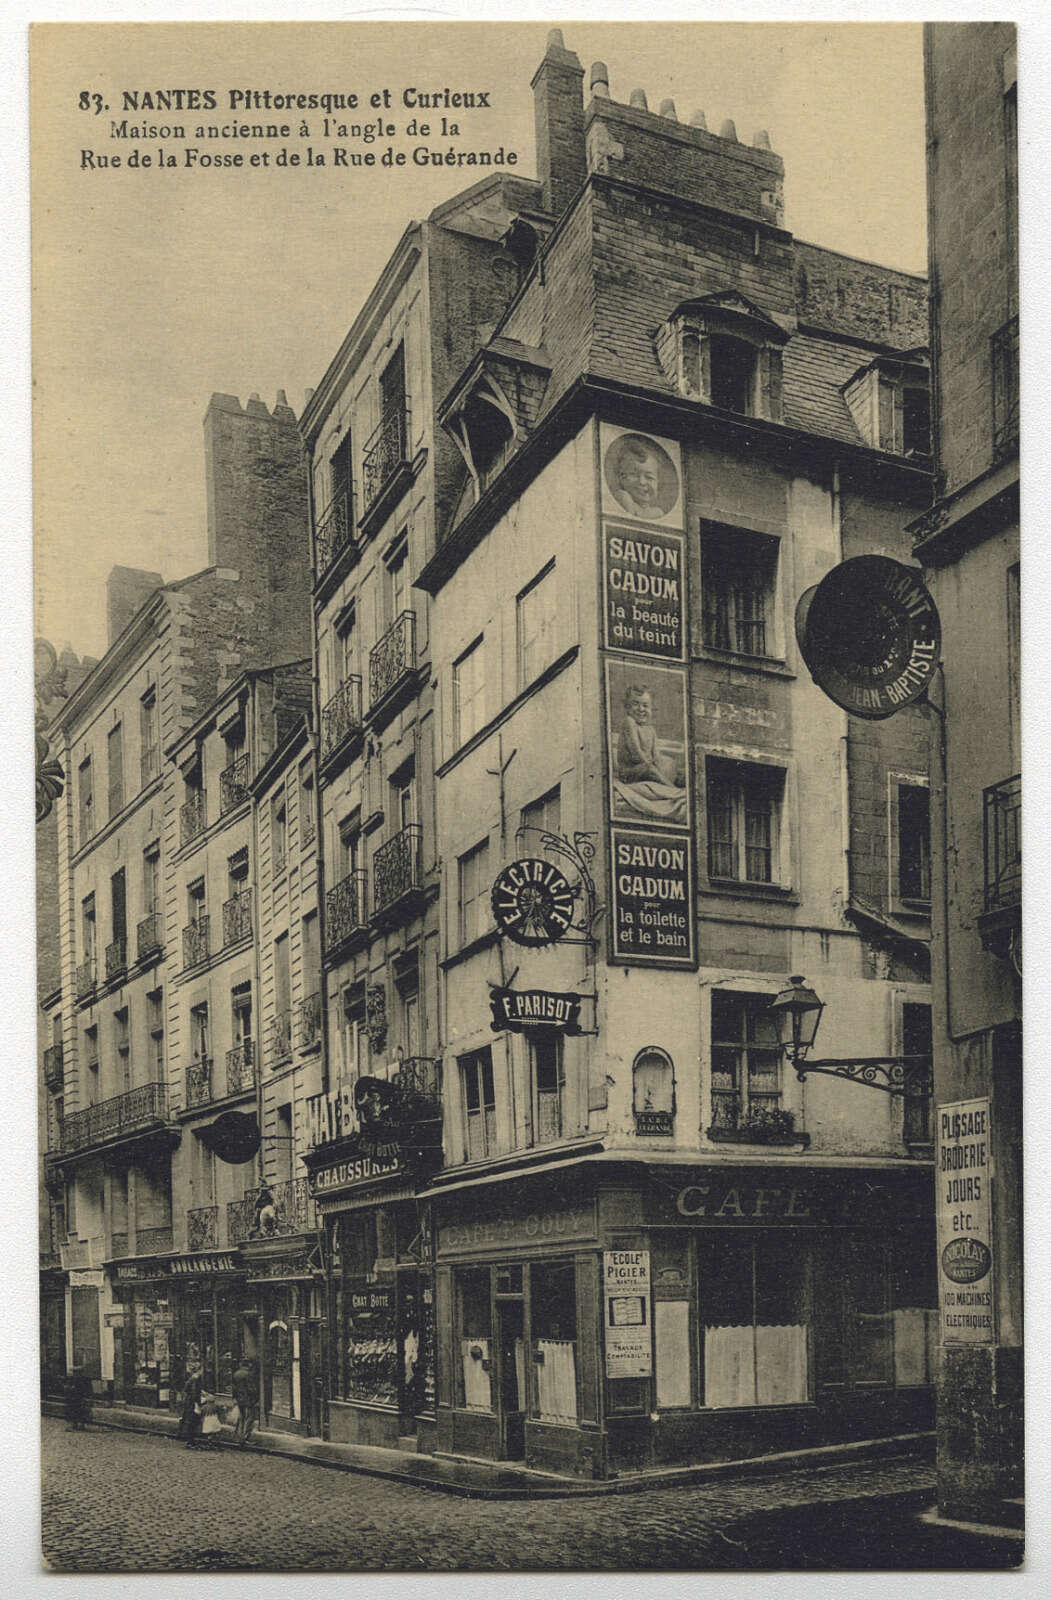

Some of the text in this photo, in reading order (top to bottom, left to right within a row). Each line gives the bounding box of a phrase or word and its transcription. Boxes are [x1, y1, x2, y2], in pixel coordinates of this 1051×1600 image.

[610, 537, 679, 570] SAVON
[610, 568, 679, 601] CADUM
[611, 601, 680, 629] la beauté
[614, 622, 677, 647] du teint
[618, 844, 685, 871] SAVON
[499, 861, 574, 929] ELECTRICITE
[619, 874, 686, 901] CADUM
[620, 907, 686, 928] la toilette
[620, 928, 687, 946] et le bain
[941, 1110, 986, 1139] PLISSAGE
[941, 1142, 987, 1173] BRODERIE
[946, 1176, 981, 1205] JOURS
[607, 1266, 647, 1278] PIGIER
[956, 1291, 991, 1307] MACHINES
